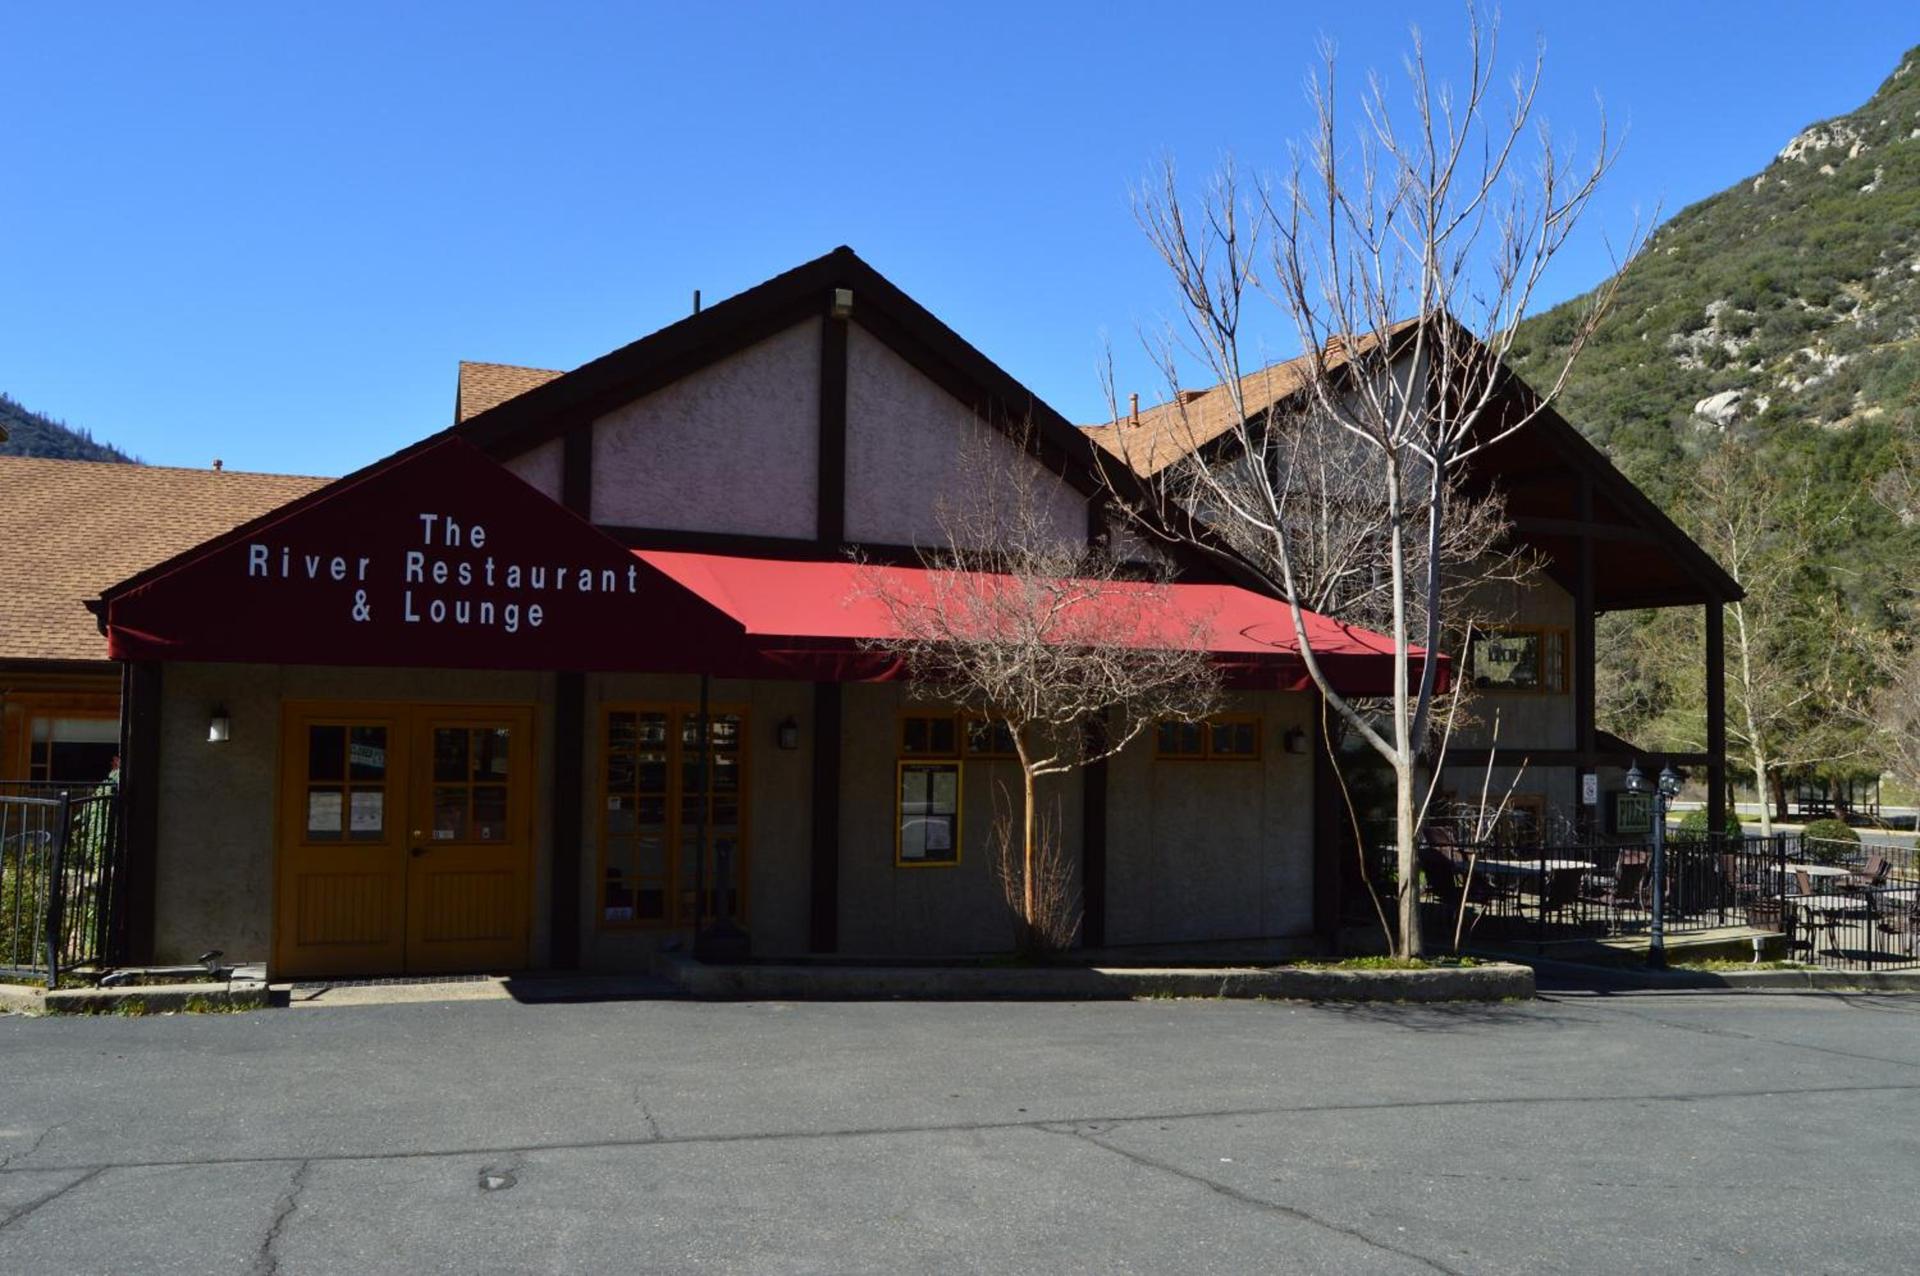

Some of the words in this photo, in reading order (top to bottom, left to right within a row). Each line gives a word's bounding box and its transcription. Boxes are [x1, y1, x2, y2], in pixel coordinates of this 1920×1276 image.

[419, 513, 486, 548] The
[248, 544, 369, 581] River
[406, 551, 637, 593] Restaurant
[352, 589, 371, 621] &
[405, 591, 543, 632] Lounge
